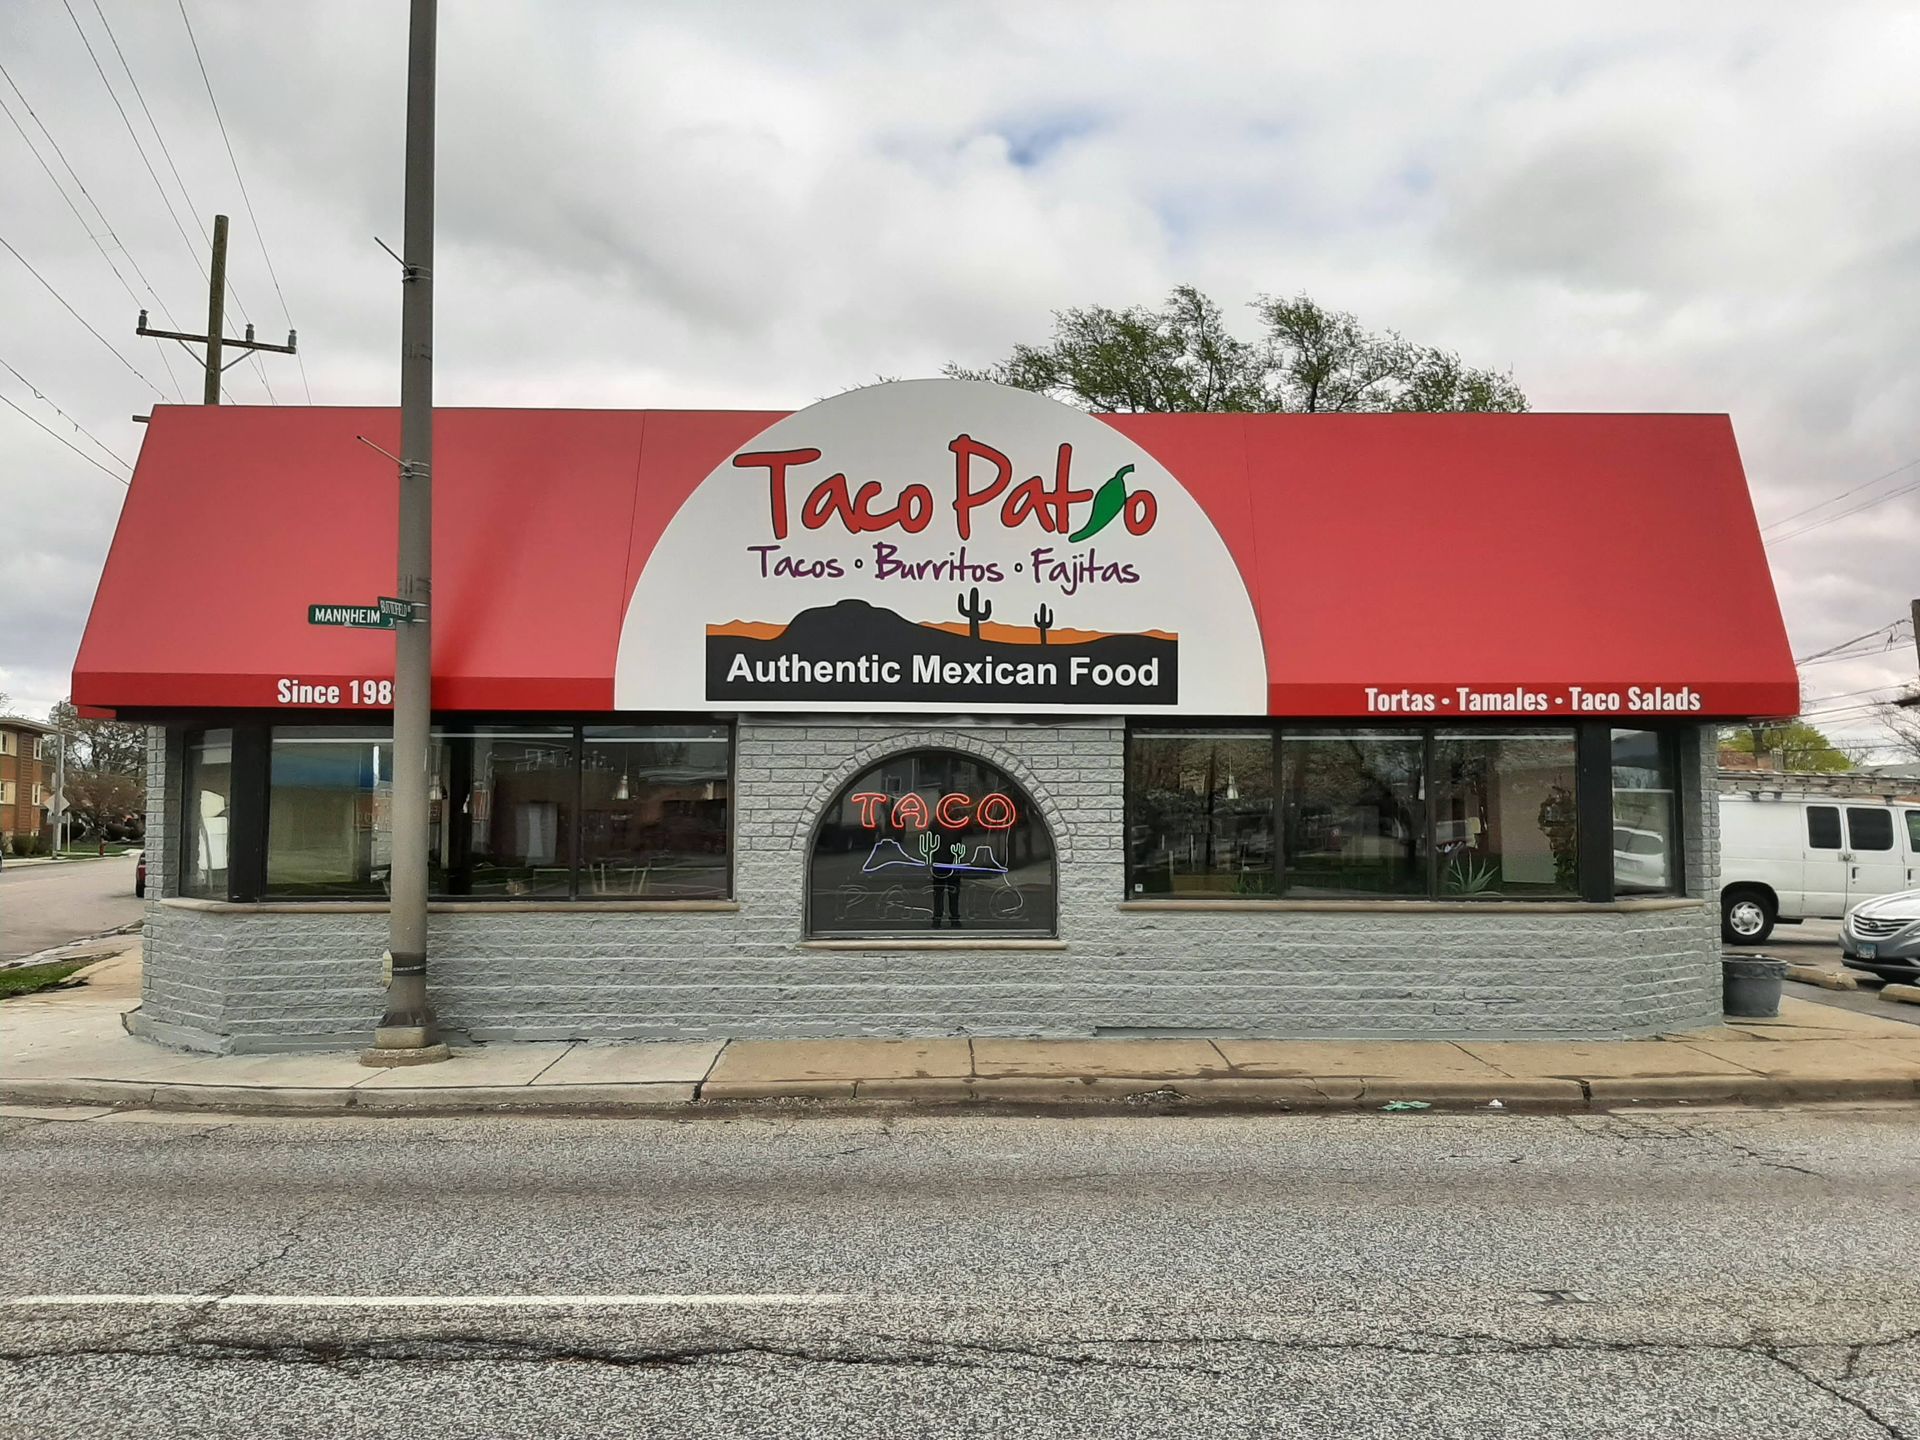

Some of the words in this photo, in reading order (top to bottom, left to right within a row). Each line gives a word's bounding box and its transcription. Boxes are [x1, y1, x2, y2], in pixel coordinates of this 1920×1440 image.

[732, 447, 933, 540] Taco
[747, 544, 845, 579] Tacos
[872, 541, 1004, 583] Burritos
[1031, 547, 1140, 596] Fajitas
[315, 607, 380, 624] MANNHEIM
[726, 653, 901, 683] Authentic
[912, 654, 1057, 685] Mexican
[1069, 656, 1160, 687] Food
[277, 678, 340, 704] Since
[349, 679, 396, 705] 198
[1365, 687, 1435, 712] Tortas
[1456, 687, 1548, 711] Tamales
[1568, 686, 1620, 711] Taco
[1628, 686, 1701, 711] Salads
[851, 792, 1017, 828] TACO
